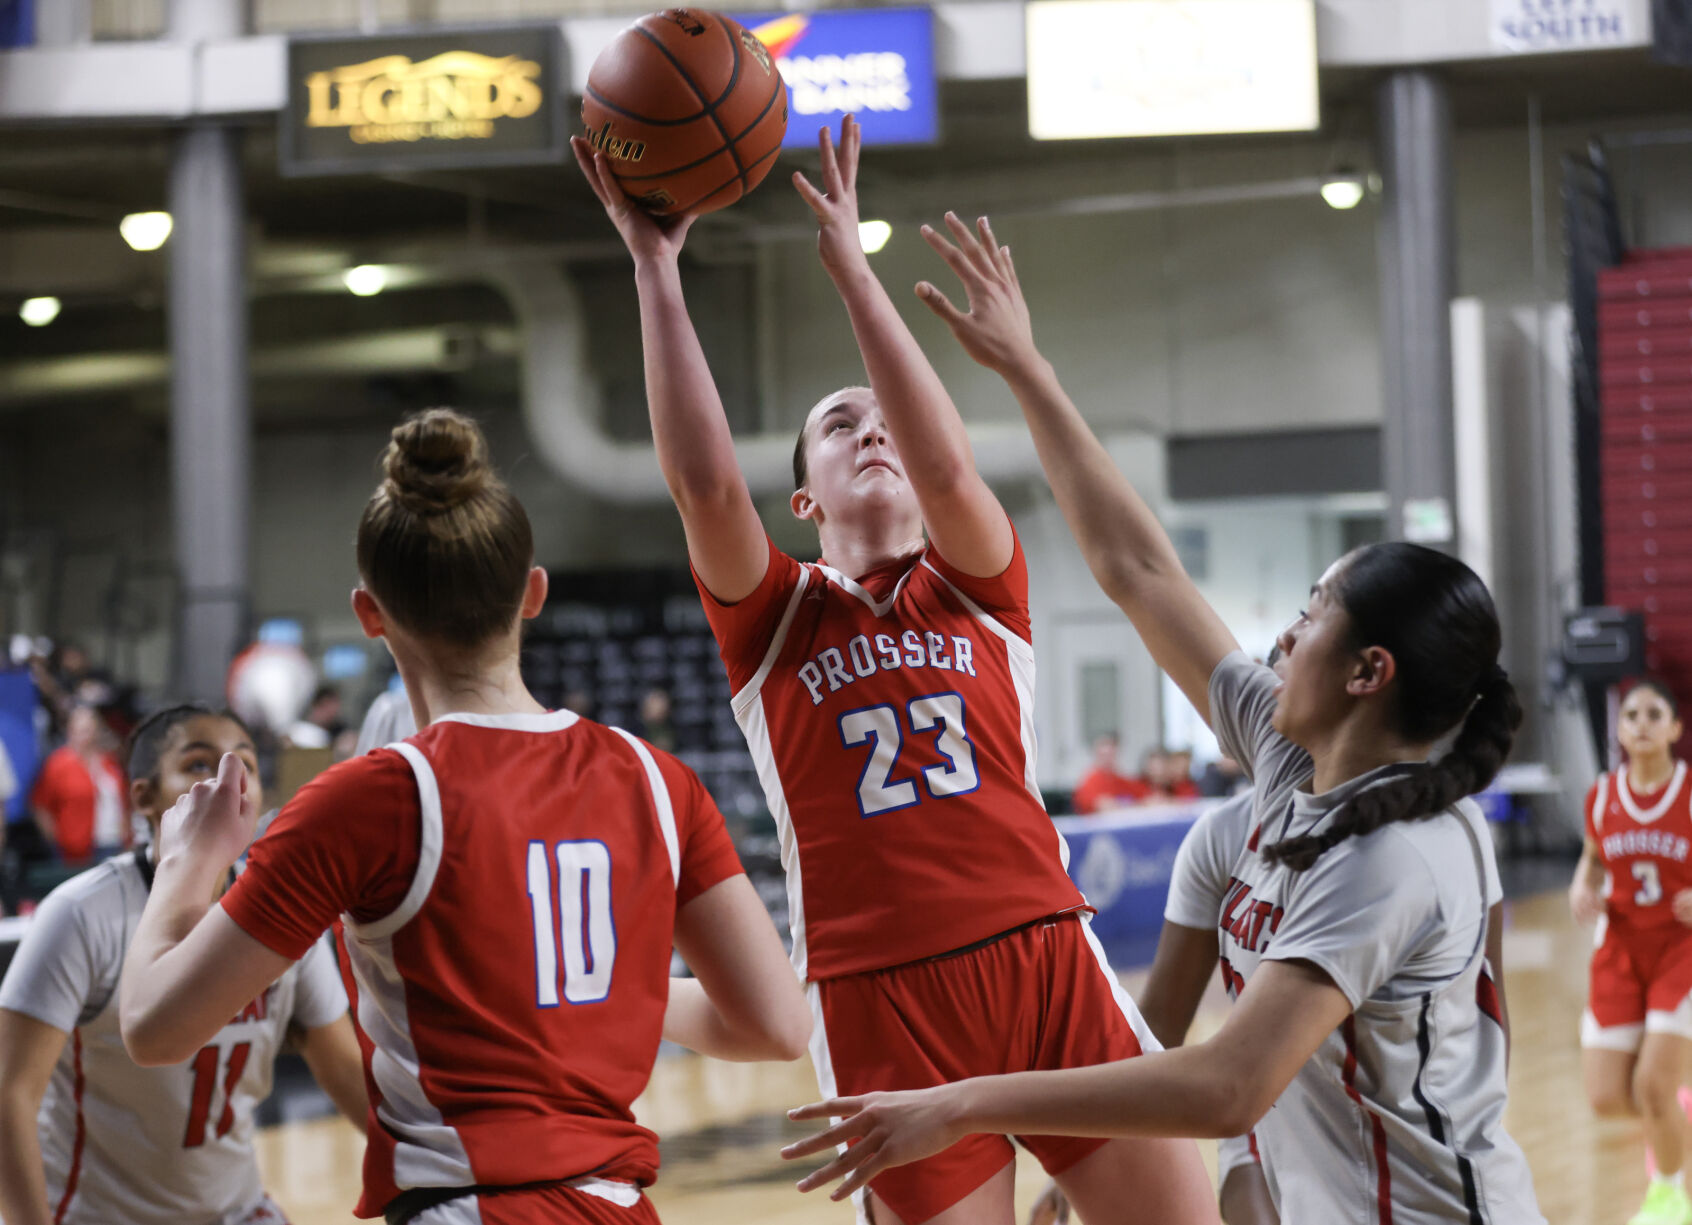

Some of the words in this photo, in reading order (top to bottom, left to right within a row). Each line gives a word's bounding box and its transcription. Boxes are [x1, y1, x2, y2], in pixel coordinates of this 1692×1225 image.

[305, 55, 542, 127] LEGENDS
[797, 629, 977, 707] PROSSER
[837, 690, 981, 819] 23
[526, 839, 618, 1009] 10
[1631, 861, 1663, 906] 3
[182, 1041, 252, 1148] 11
